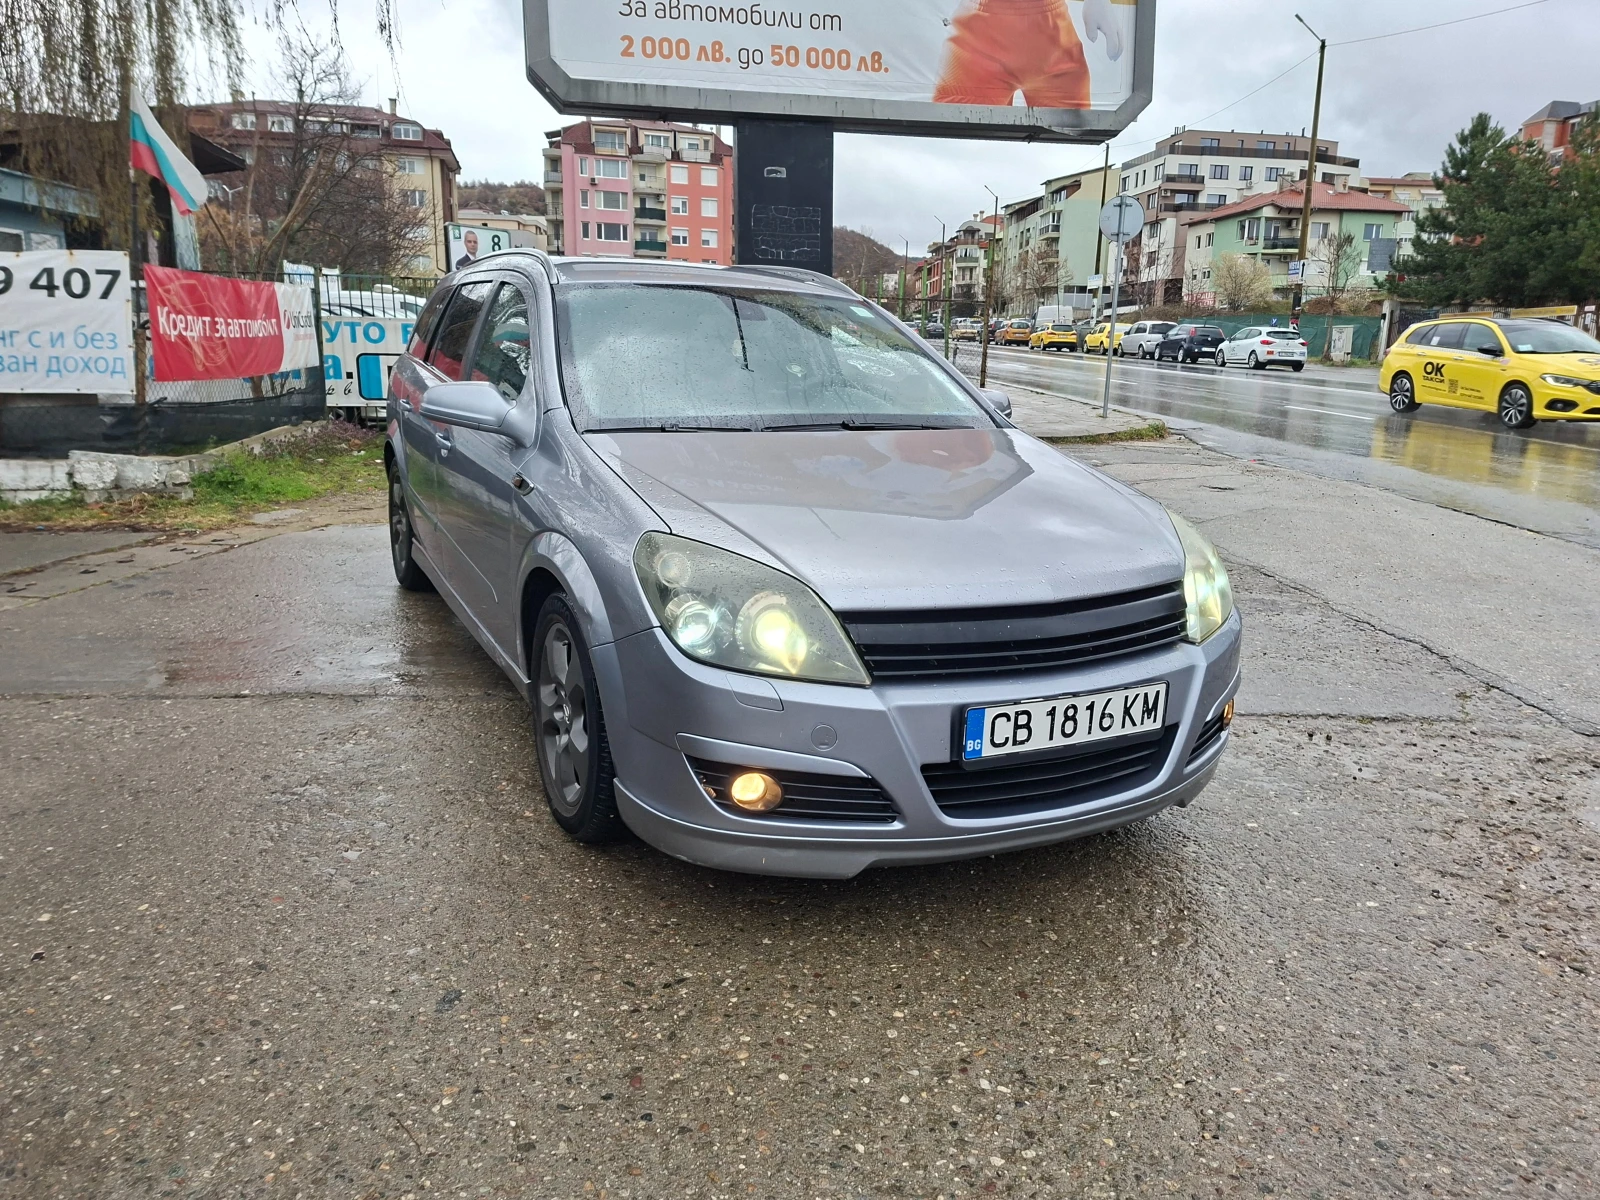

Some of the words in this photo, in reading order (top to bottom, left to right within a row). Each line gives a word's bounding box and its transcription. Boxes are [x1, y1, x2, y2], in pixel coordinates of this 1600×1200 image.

[618, 0, 647, 18] За
[654, 0, 803, 29] автомобили
[809, 13, 843, 32] от
[620, 34, 635, 58] 2
[641, 36, 691, 61] 000
[696, 40, 732, 63] лв.
[738, 47, 764, 70] до
[770, 44, 800, 68] 50
[805, 46, 851, 71] 000
[856, 50, 890, 74] лв.
[491, 234, 502, 252] 8
[29, 267, 122, 300] 407
[28, 330, 41, 348] с
[50, 331, 65, 349] и
[74, 325, 118, 350] без
[156, 305, 211, 342] Кредит
[214, 317, 227, 338] за
[46, 355, 127, 379] доход
[1422, 375, 1446, 384] ТАКСИ
[989, 709, 1033, 749] CB
[1046, 696, 1116, 742] 1816
[1121, 689, 1161, 729] KM
[966, 739, 981, 752] BG
